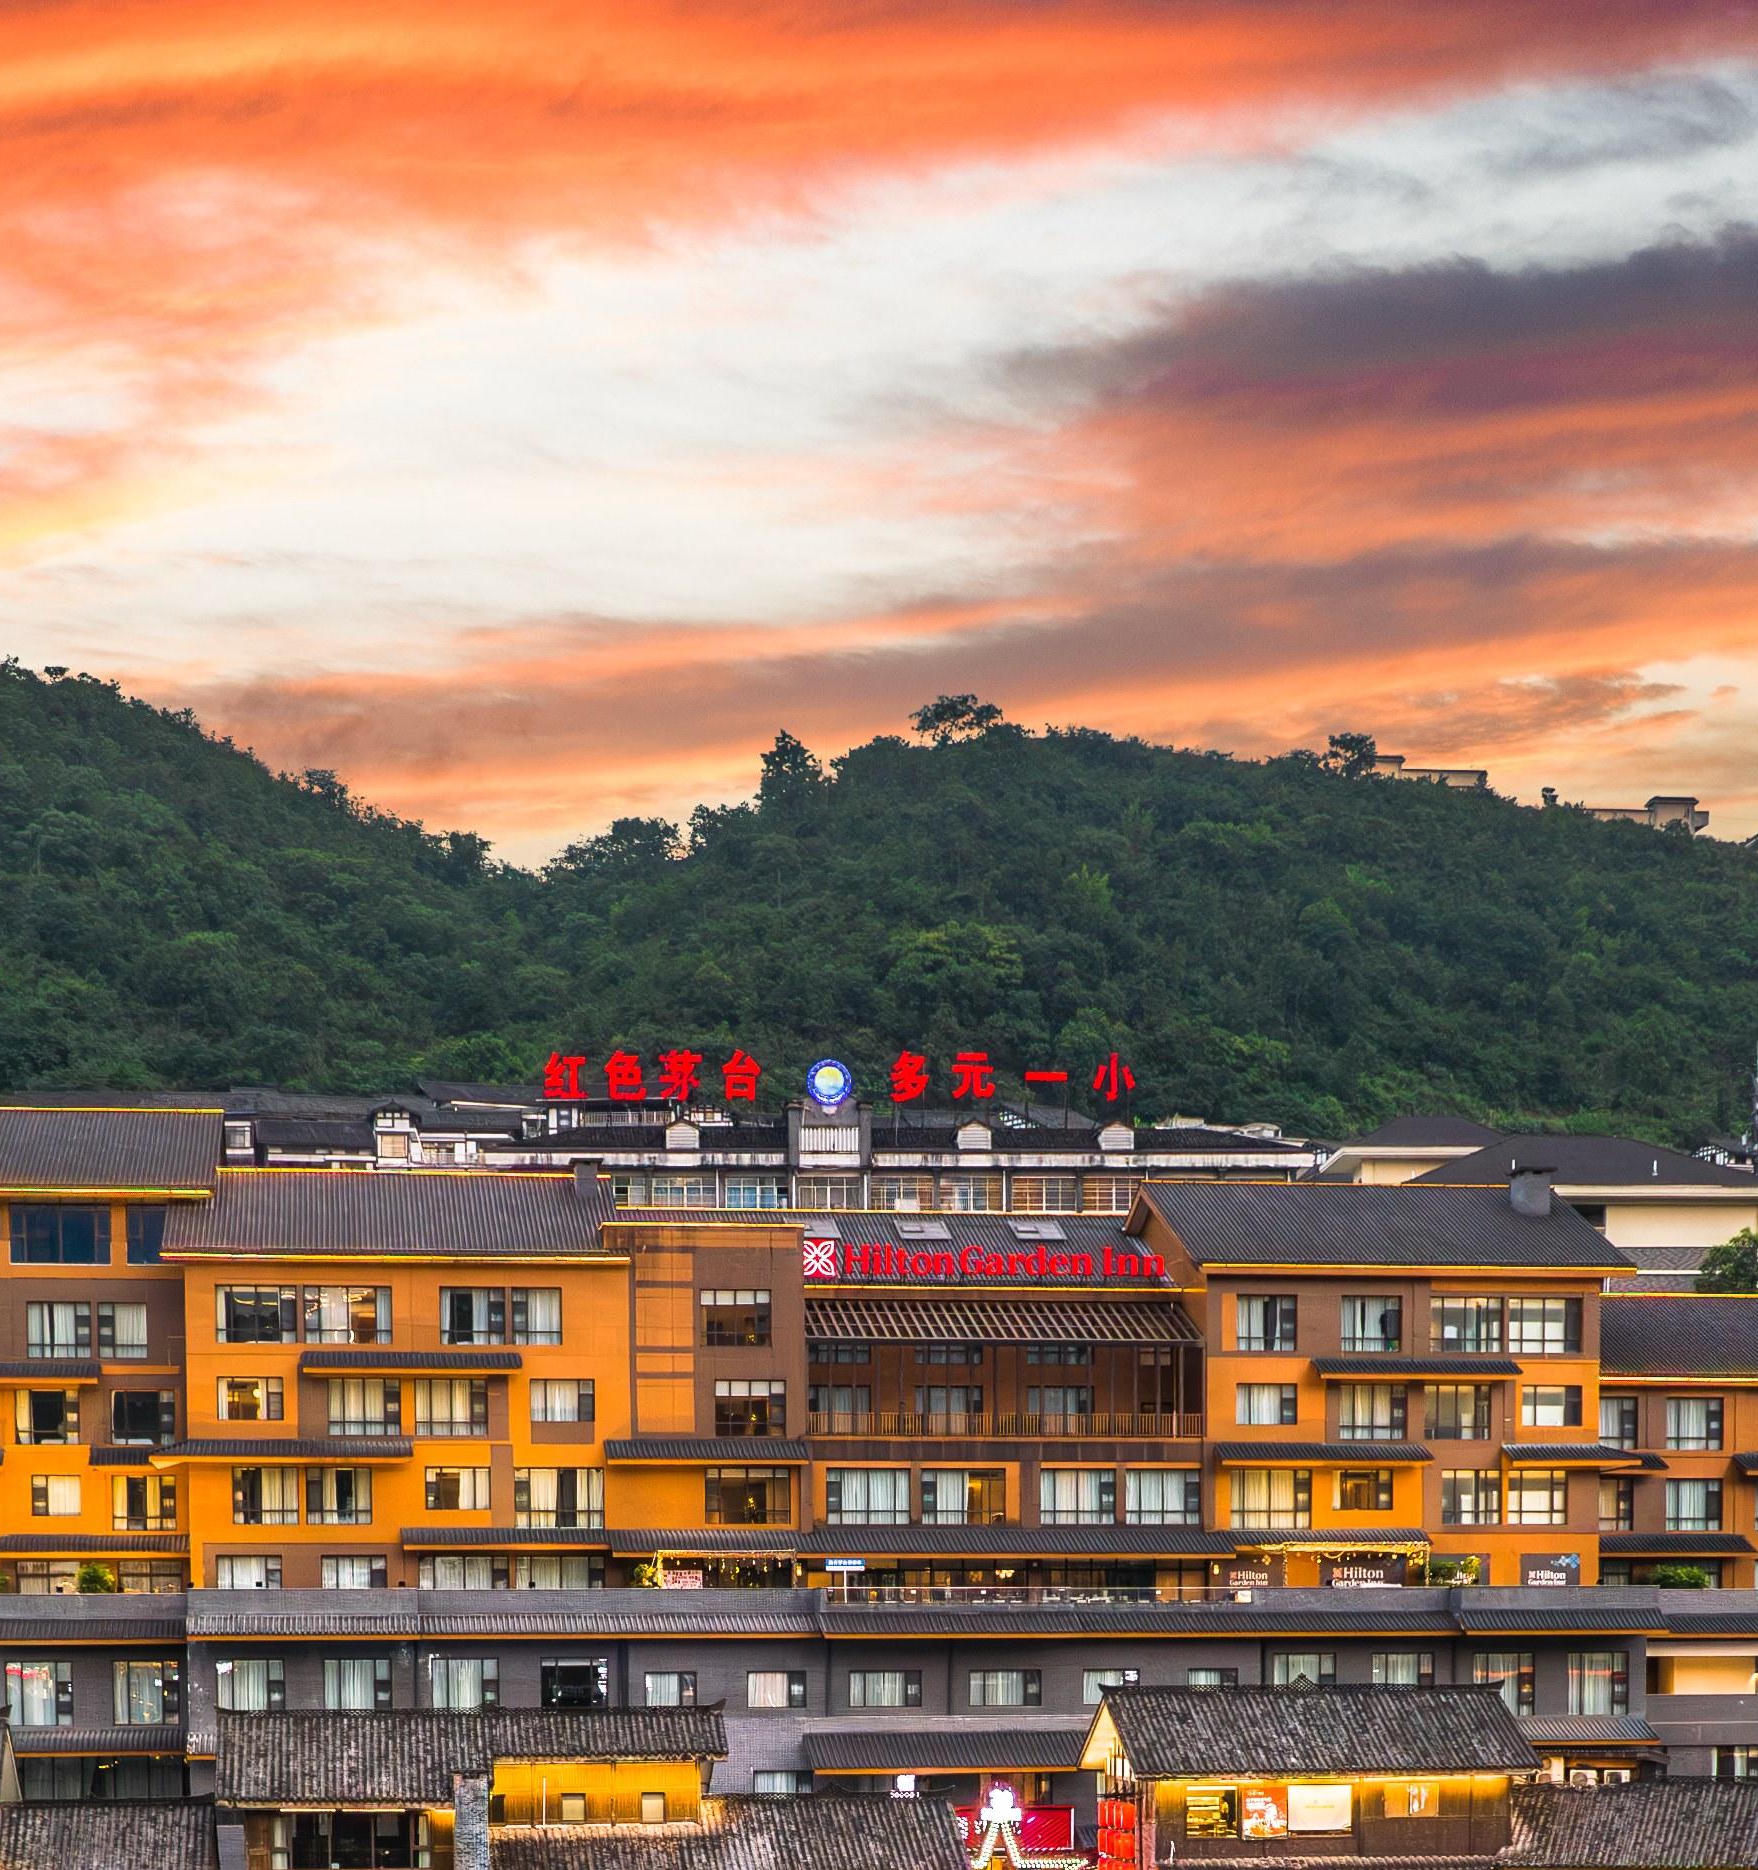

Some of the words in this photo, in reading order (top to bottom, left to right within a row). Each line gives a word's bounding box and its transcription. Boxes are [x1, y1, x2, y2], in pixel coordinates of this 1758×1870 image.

[543, 1048, 762, 1102] 红色茅台
[889, 1050, 1136, 1102] 多元一小
[844, 1242, 954, 1276] Hilton
[960, 1245, 1093, 1278] Garden
[1102, 1246, 1166, 1279] Inn
